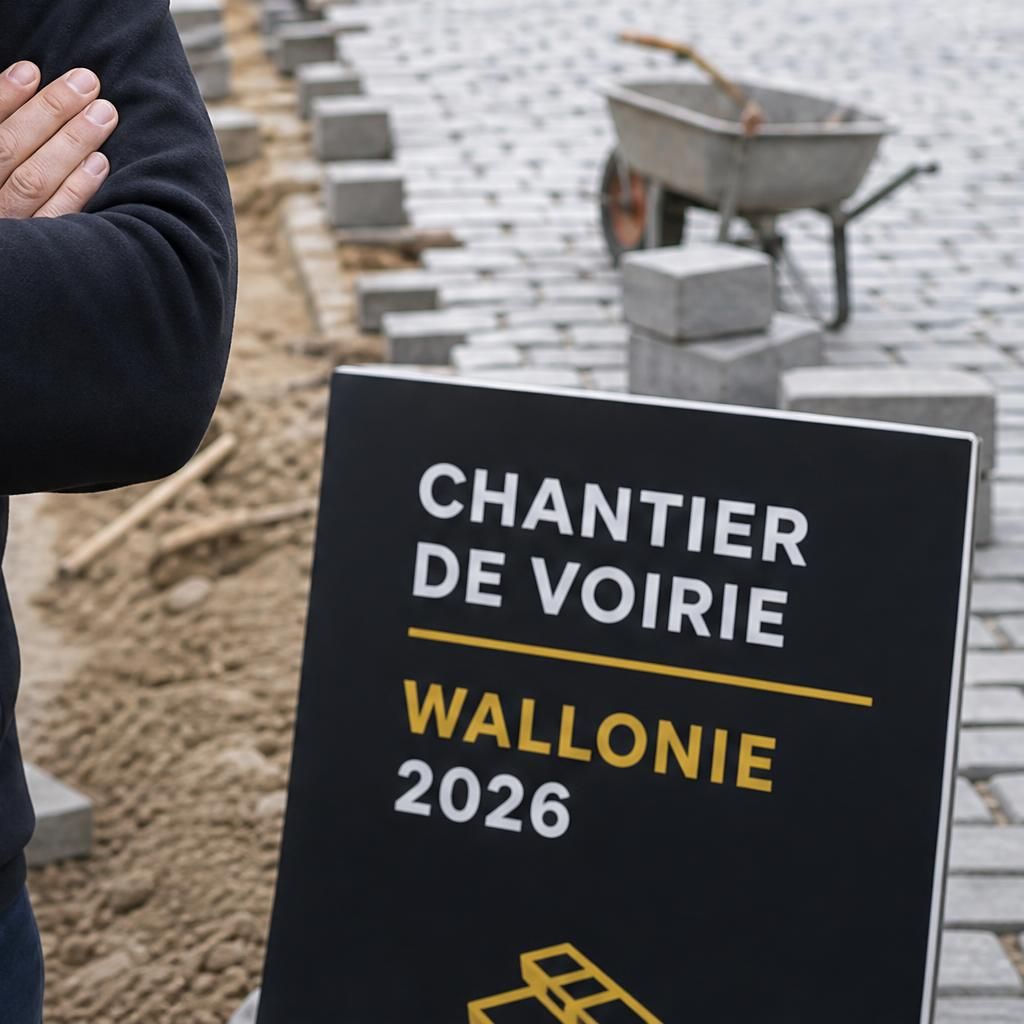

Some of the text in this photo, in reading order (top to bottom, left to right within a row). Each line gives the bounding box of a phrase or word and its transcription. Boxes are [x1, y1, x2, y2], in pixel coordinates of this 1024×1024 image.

[418, 463, 808, 567] CHANTIER
[414, 543, 789, 648] DE VOIRIE
[403, 679, 777, 792] WALLONIE
[395, 758, 571, 838] 2026
